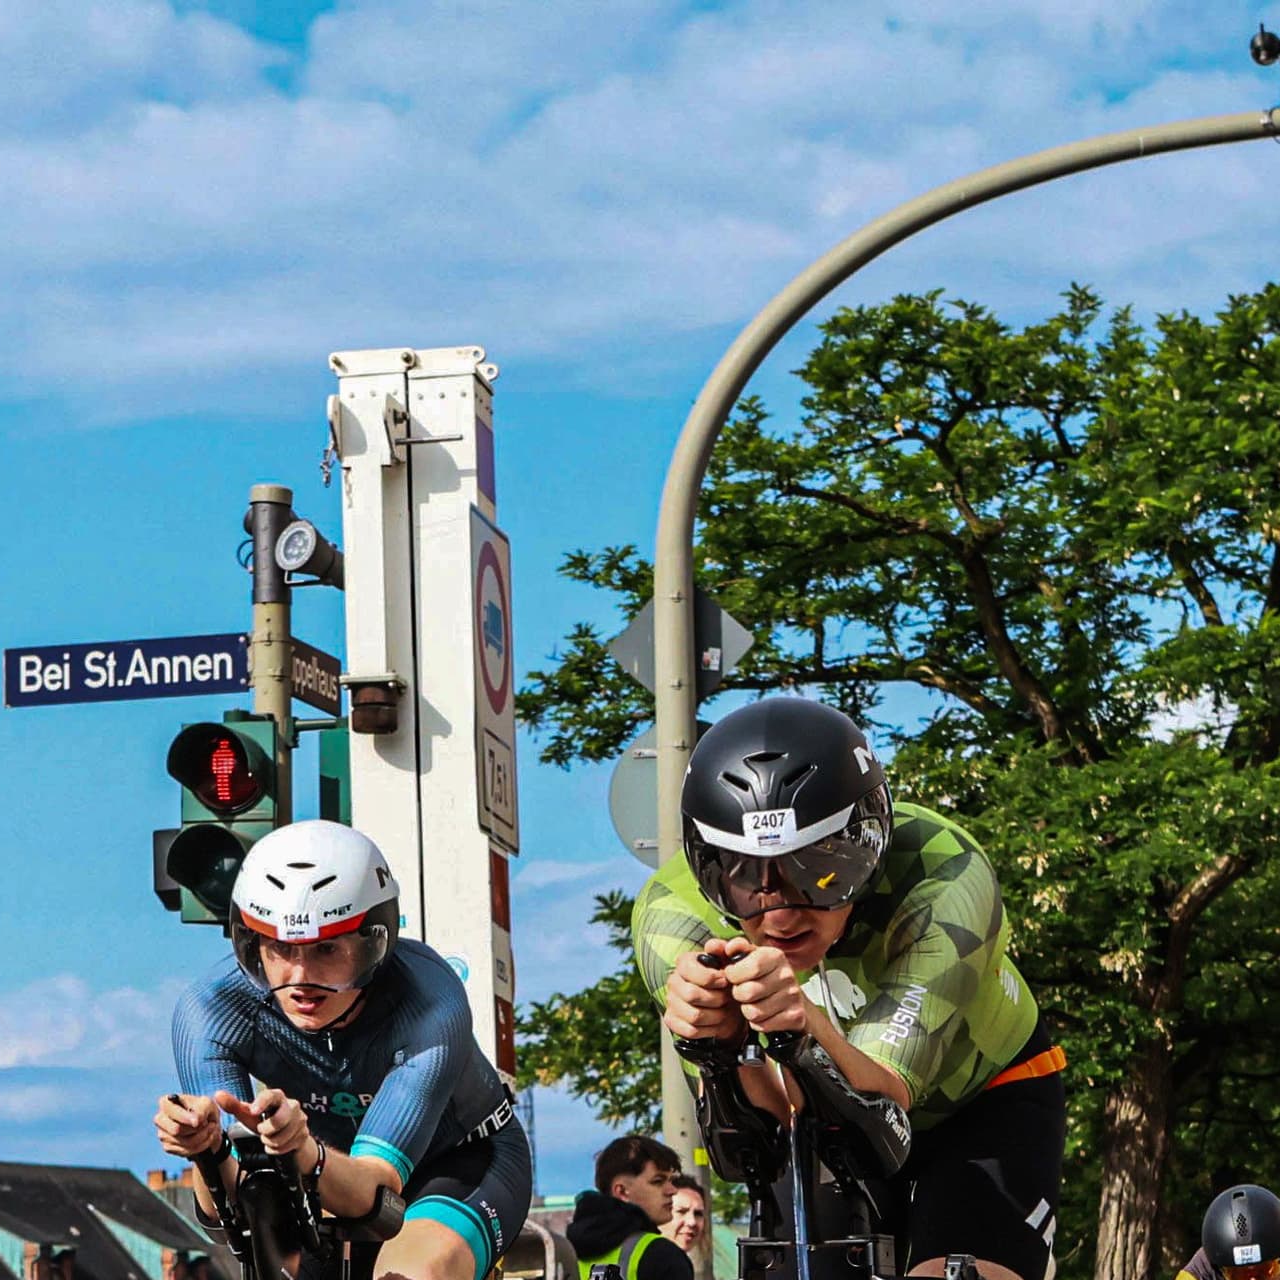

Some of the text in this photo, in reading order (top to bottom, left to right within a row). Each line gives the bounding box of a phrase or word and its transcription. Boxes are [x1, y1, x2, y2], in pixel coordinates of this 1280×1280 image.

[19, 648, 234, 693] Bei St.Annen
[752, 812, 786, 830] 2407
[249, 902, 273, 917] MET
[323, 902, 353, 918] MET
[283, 912, 311, 927] 1844
[879, 983, 929, 1049] FUSION
